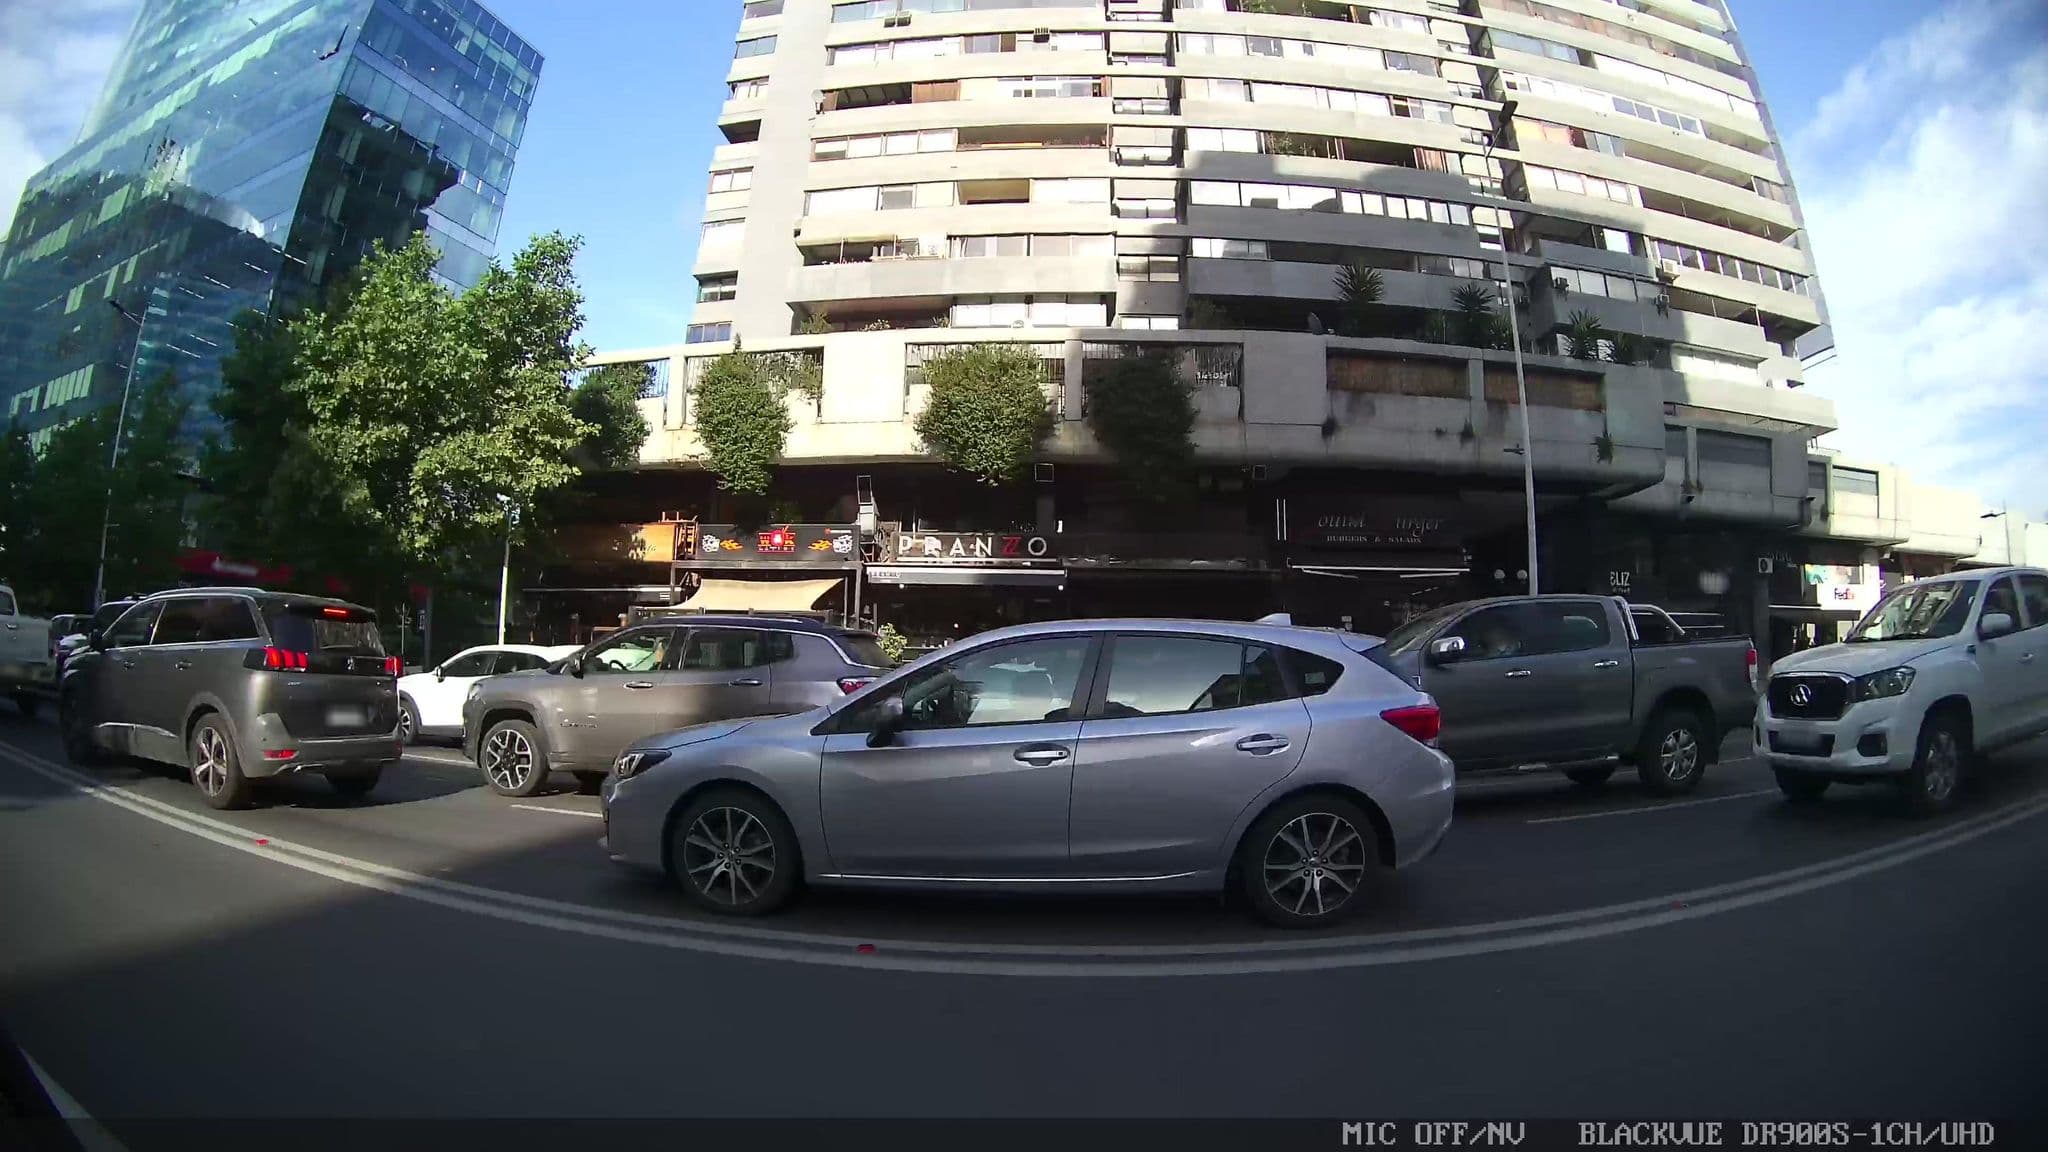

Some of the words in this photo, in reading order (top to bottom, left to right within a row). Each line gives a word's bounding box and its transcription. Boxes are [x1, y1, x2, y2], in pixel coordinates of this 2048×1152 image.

[898, 536, 1048, 558] PRANZO
[1326, 535, 1368, 543] BURGERS
[1388, 536, 1422, 544] SALADS
